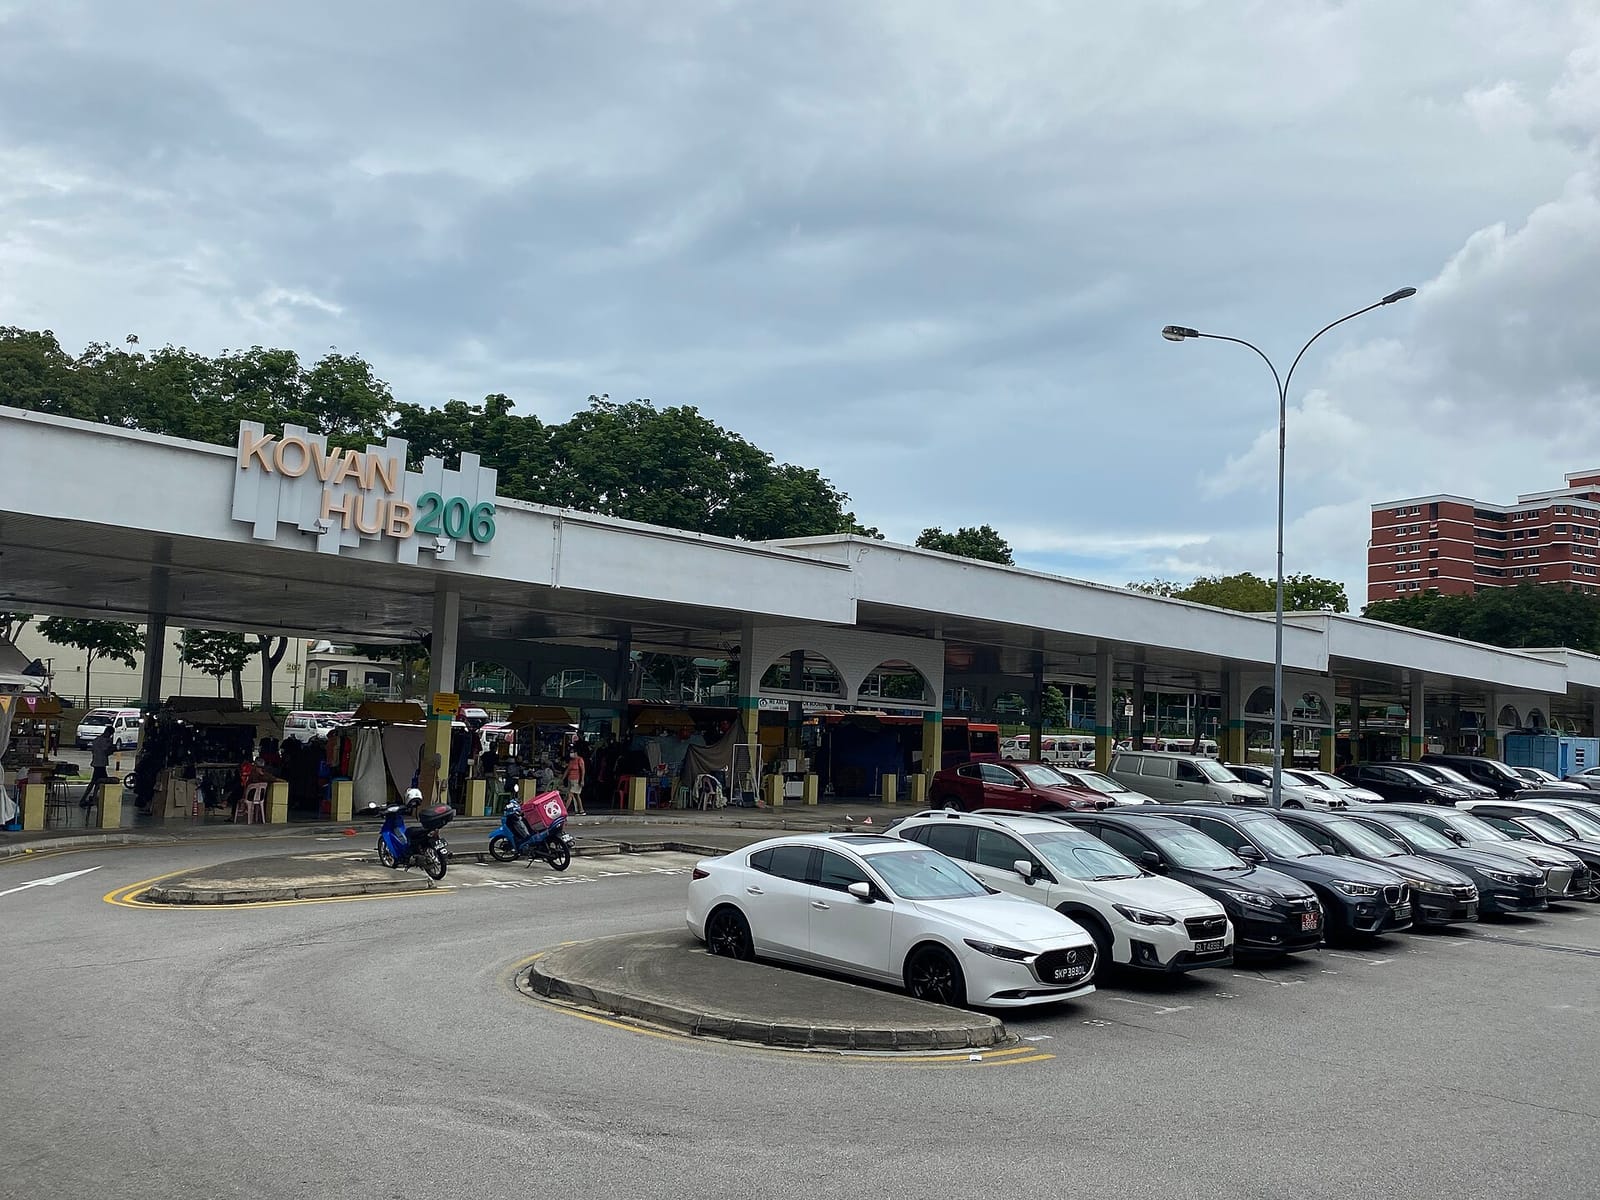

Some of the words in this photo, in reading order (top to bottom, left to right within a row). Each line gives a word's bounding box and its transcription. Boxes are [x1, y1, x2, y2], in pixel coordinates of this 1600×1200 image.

[241, 430, 398, 493] KOVAN
[322, 489, 413, 538] HUB
[415, 492, 496, 543] 206
